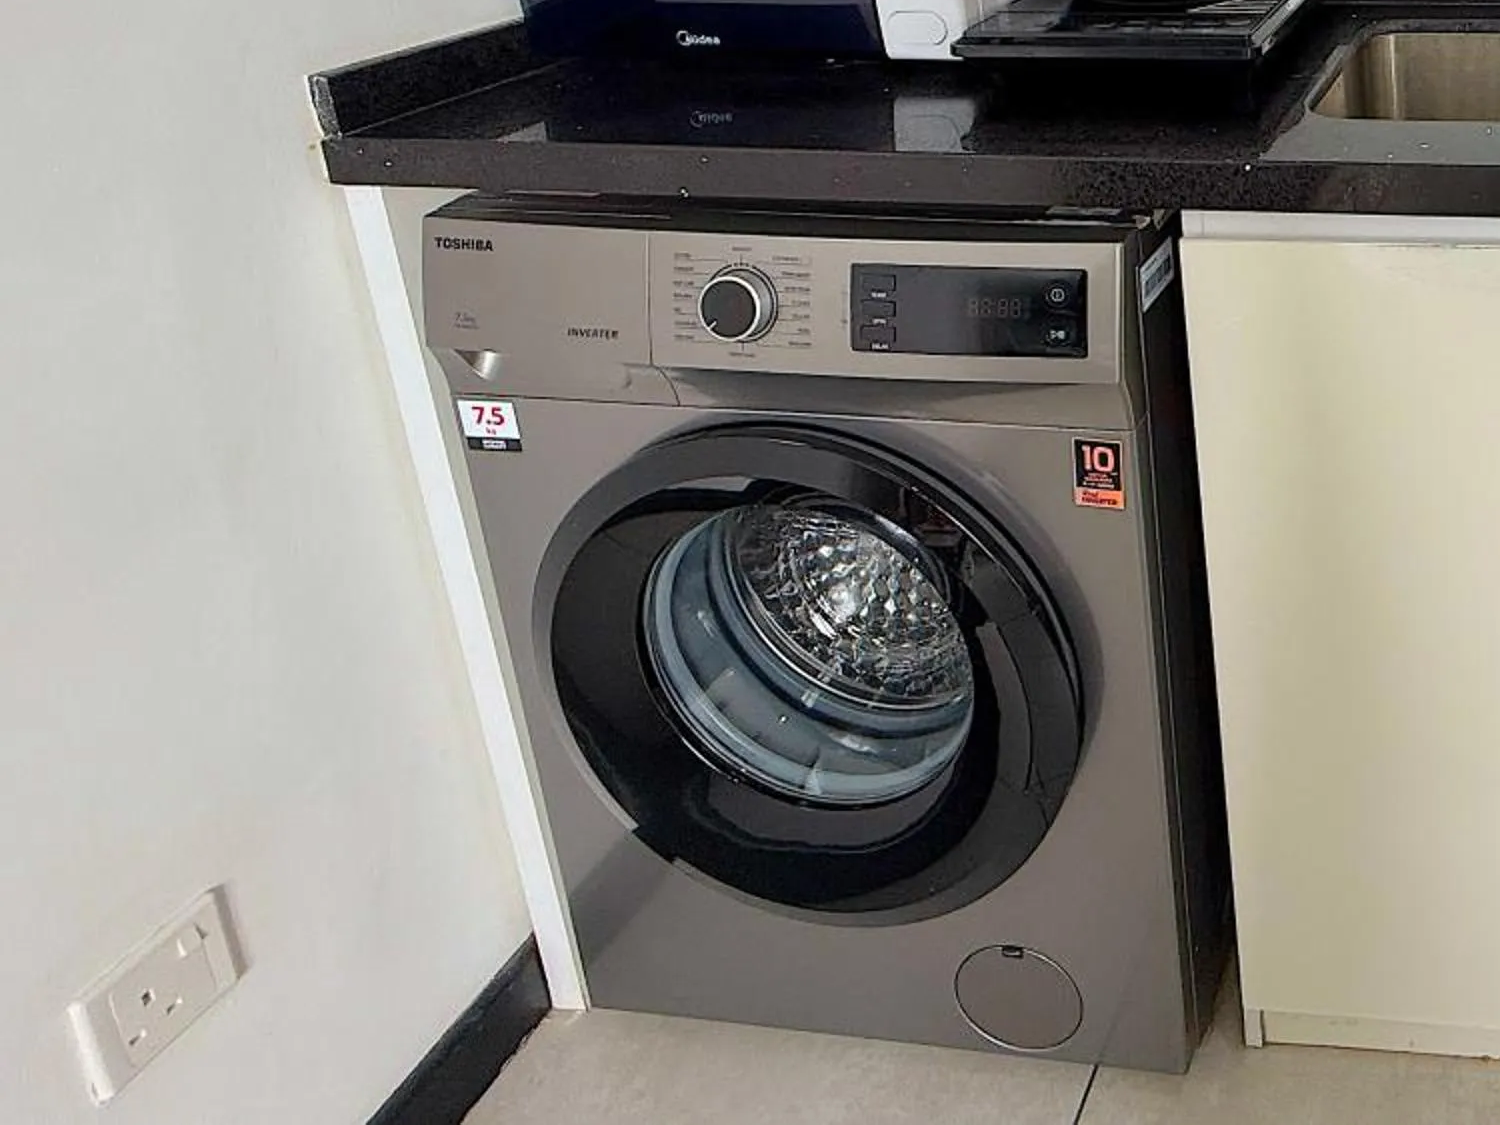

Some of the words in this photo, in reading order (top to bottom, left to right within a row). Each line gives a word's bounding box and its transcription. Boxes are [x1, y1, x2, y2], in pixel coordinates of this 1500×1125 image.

[434, 237, 494, 252] TOSHIBA
[567, 328, 619, 340] INVERTER
[471, 406, 505, 426] 7.5
[1081, 445, 1115, 472] 10
